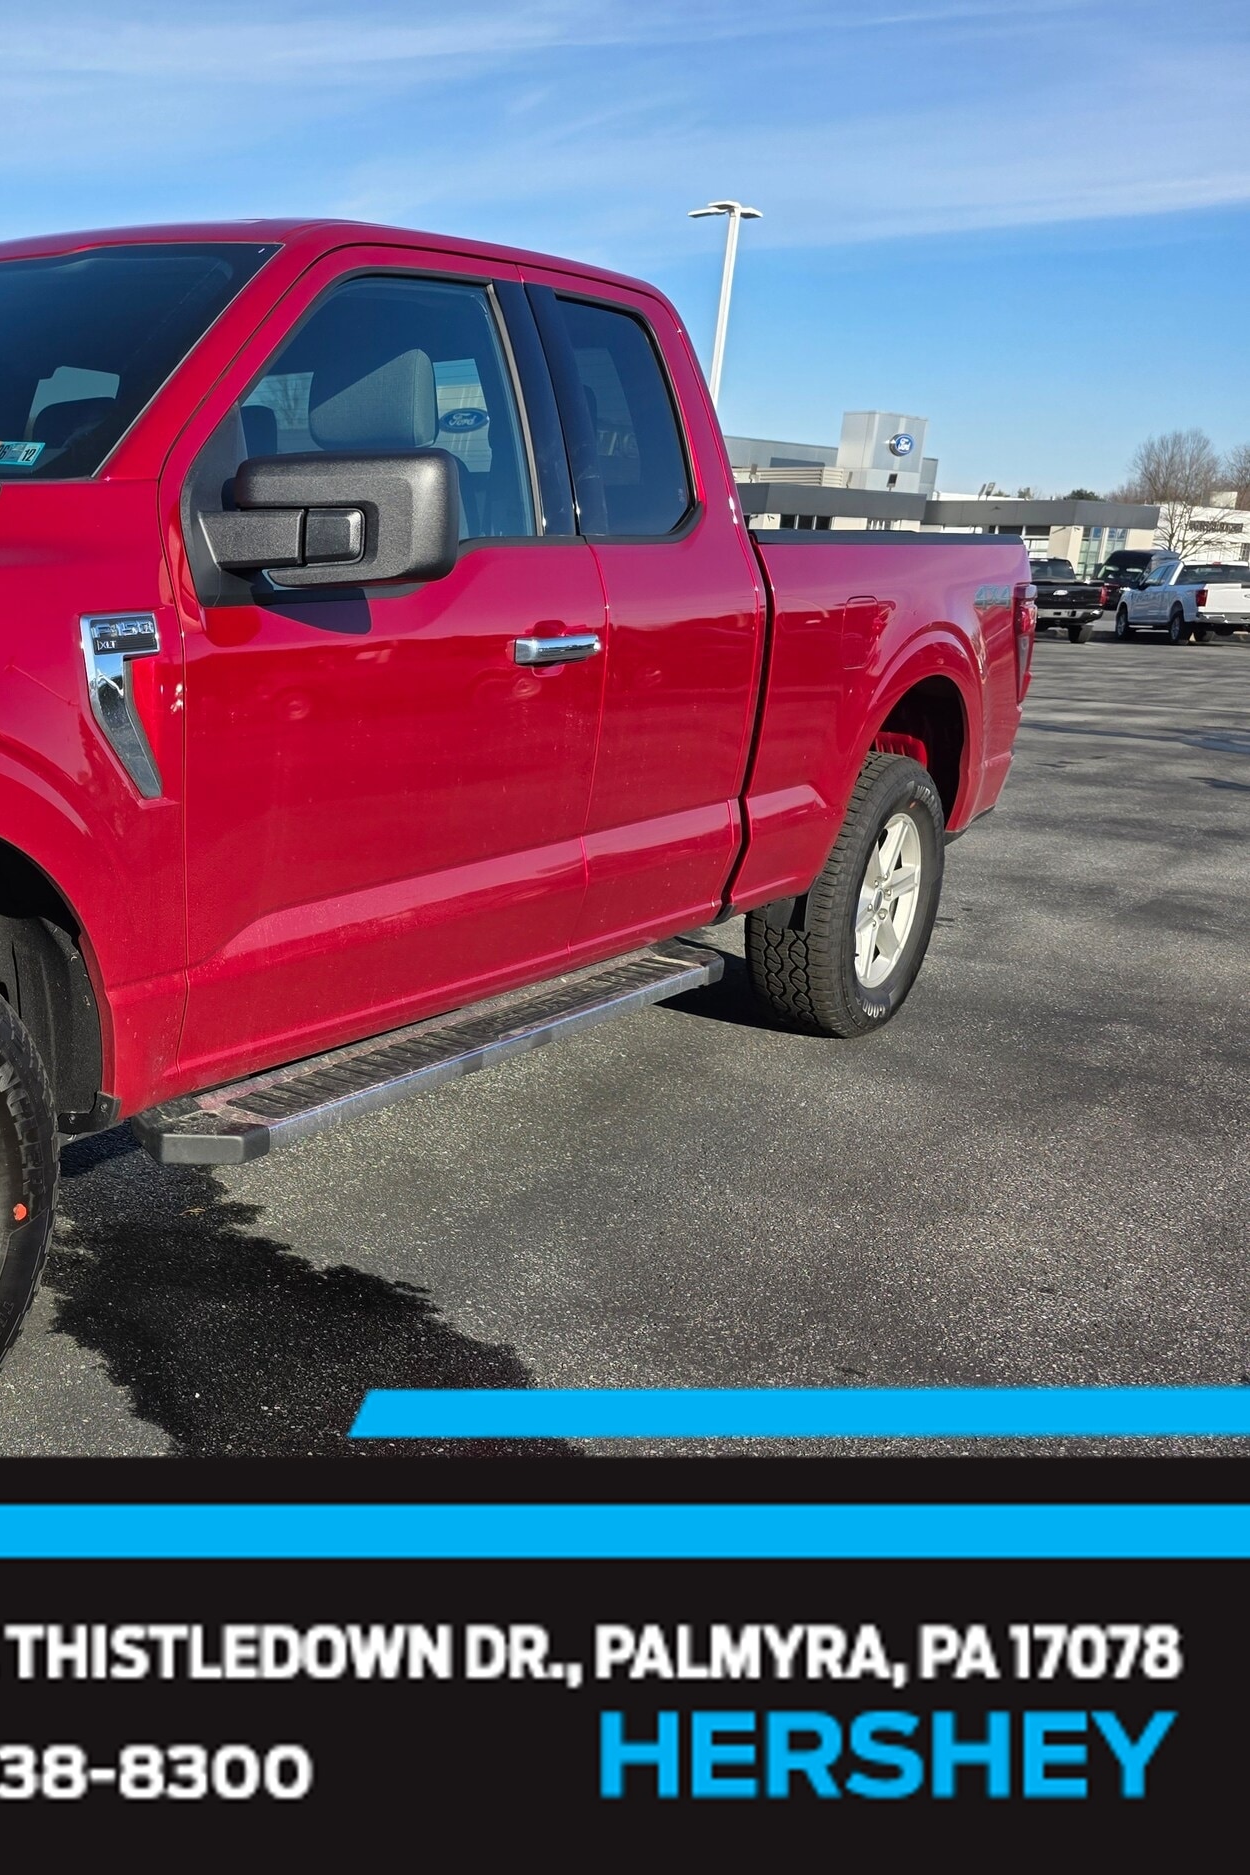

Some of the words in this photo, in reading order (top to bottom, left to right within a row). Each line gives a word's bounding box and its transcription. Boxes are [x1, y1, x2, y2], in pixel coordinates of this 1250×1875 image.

[448, 412, 478, 426] Ford
[21, 448, 37, 462] 12
[99, 640, 117, 649] XLT
